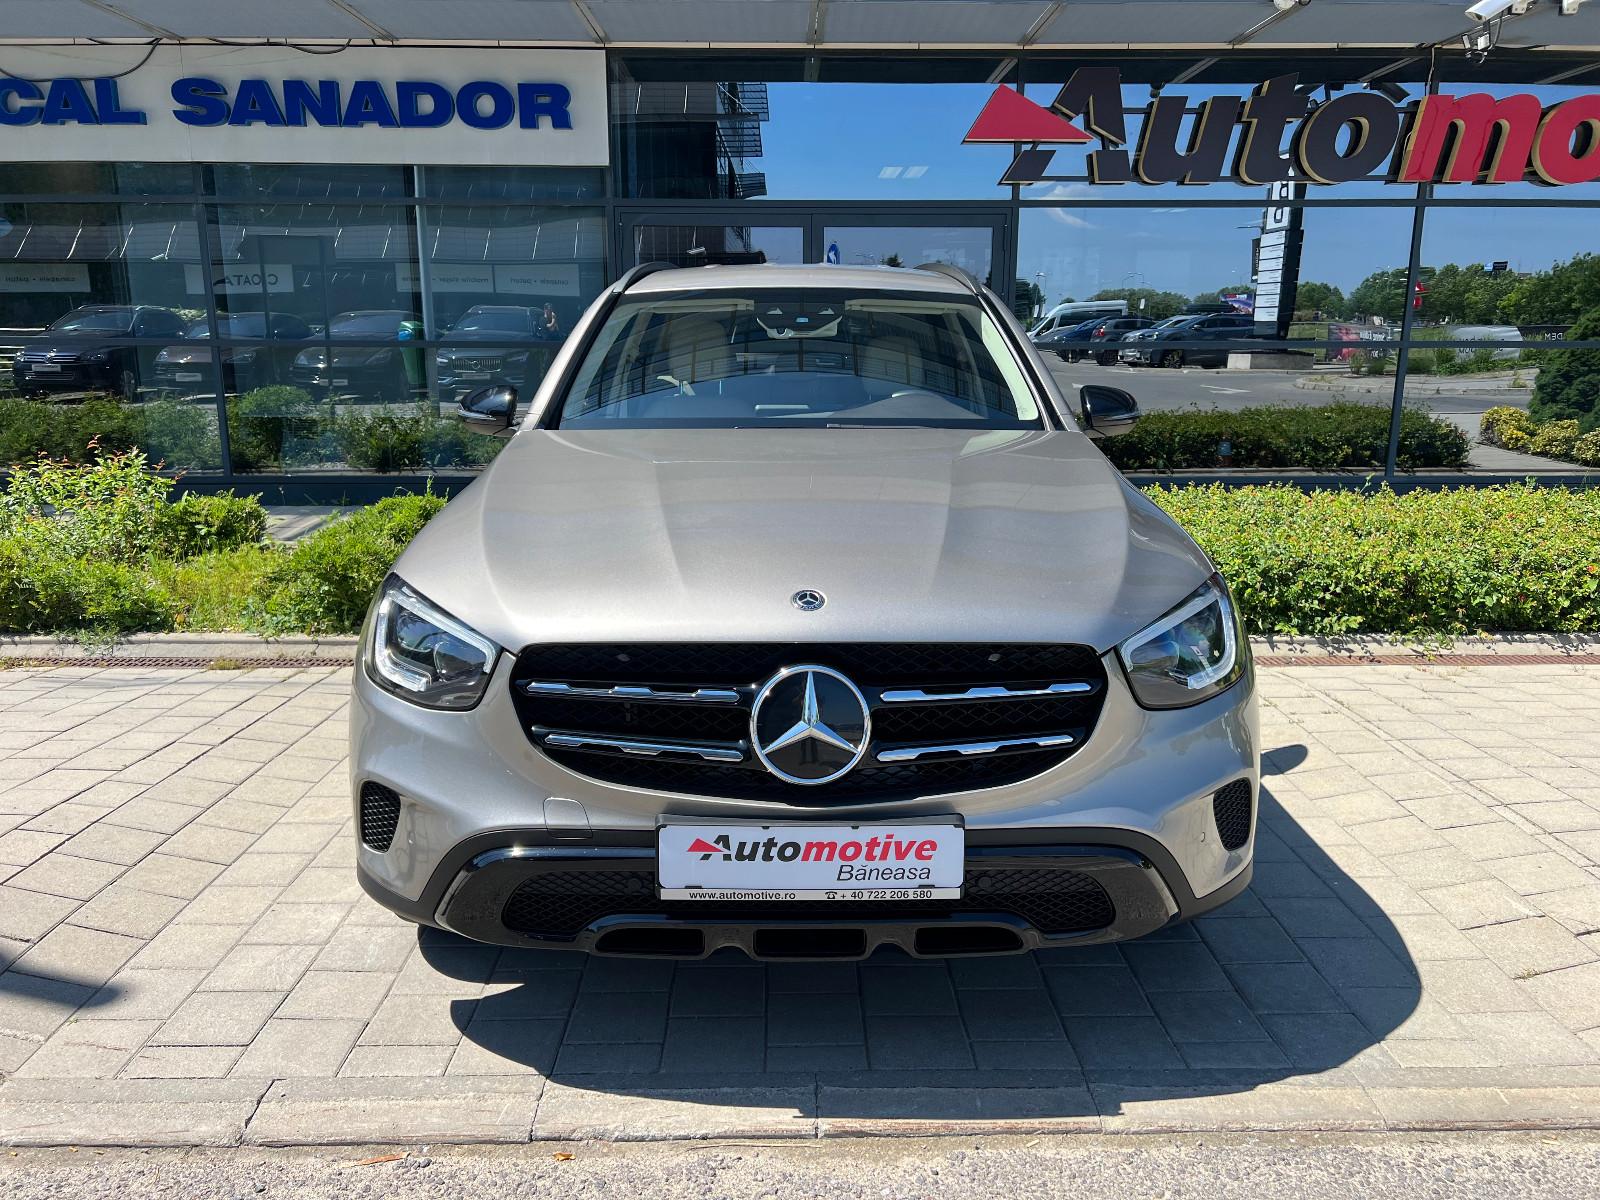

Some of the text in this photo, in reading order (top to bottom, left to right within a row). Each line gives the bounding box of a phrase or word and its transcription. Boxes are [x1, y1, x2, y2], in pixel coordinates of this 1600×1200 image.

[0, 78, 573, 131] CAL SANADOR
[687, 833, 938, 863] Automotive
[836, 863, 932, 882] Băneasa
[689, 891, 796, 900] www.automotive.ro
[850, 891, 864, 900] 40
[868, 891, 887, 900] 722
[890, 891, 910, 900] 206
[912, 890, 932, 899] 580
